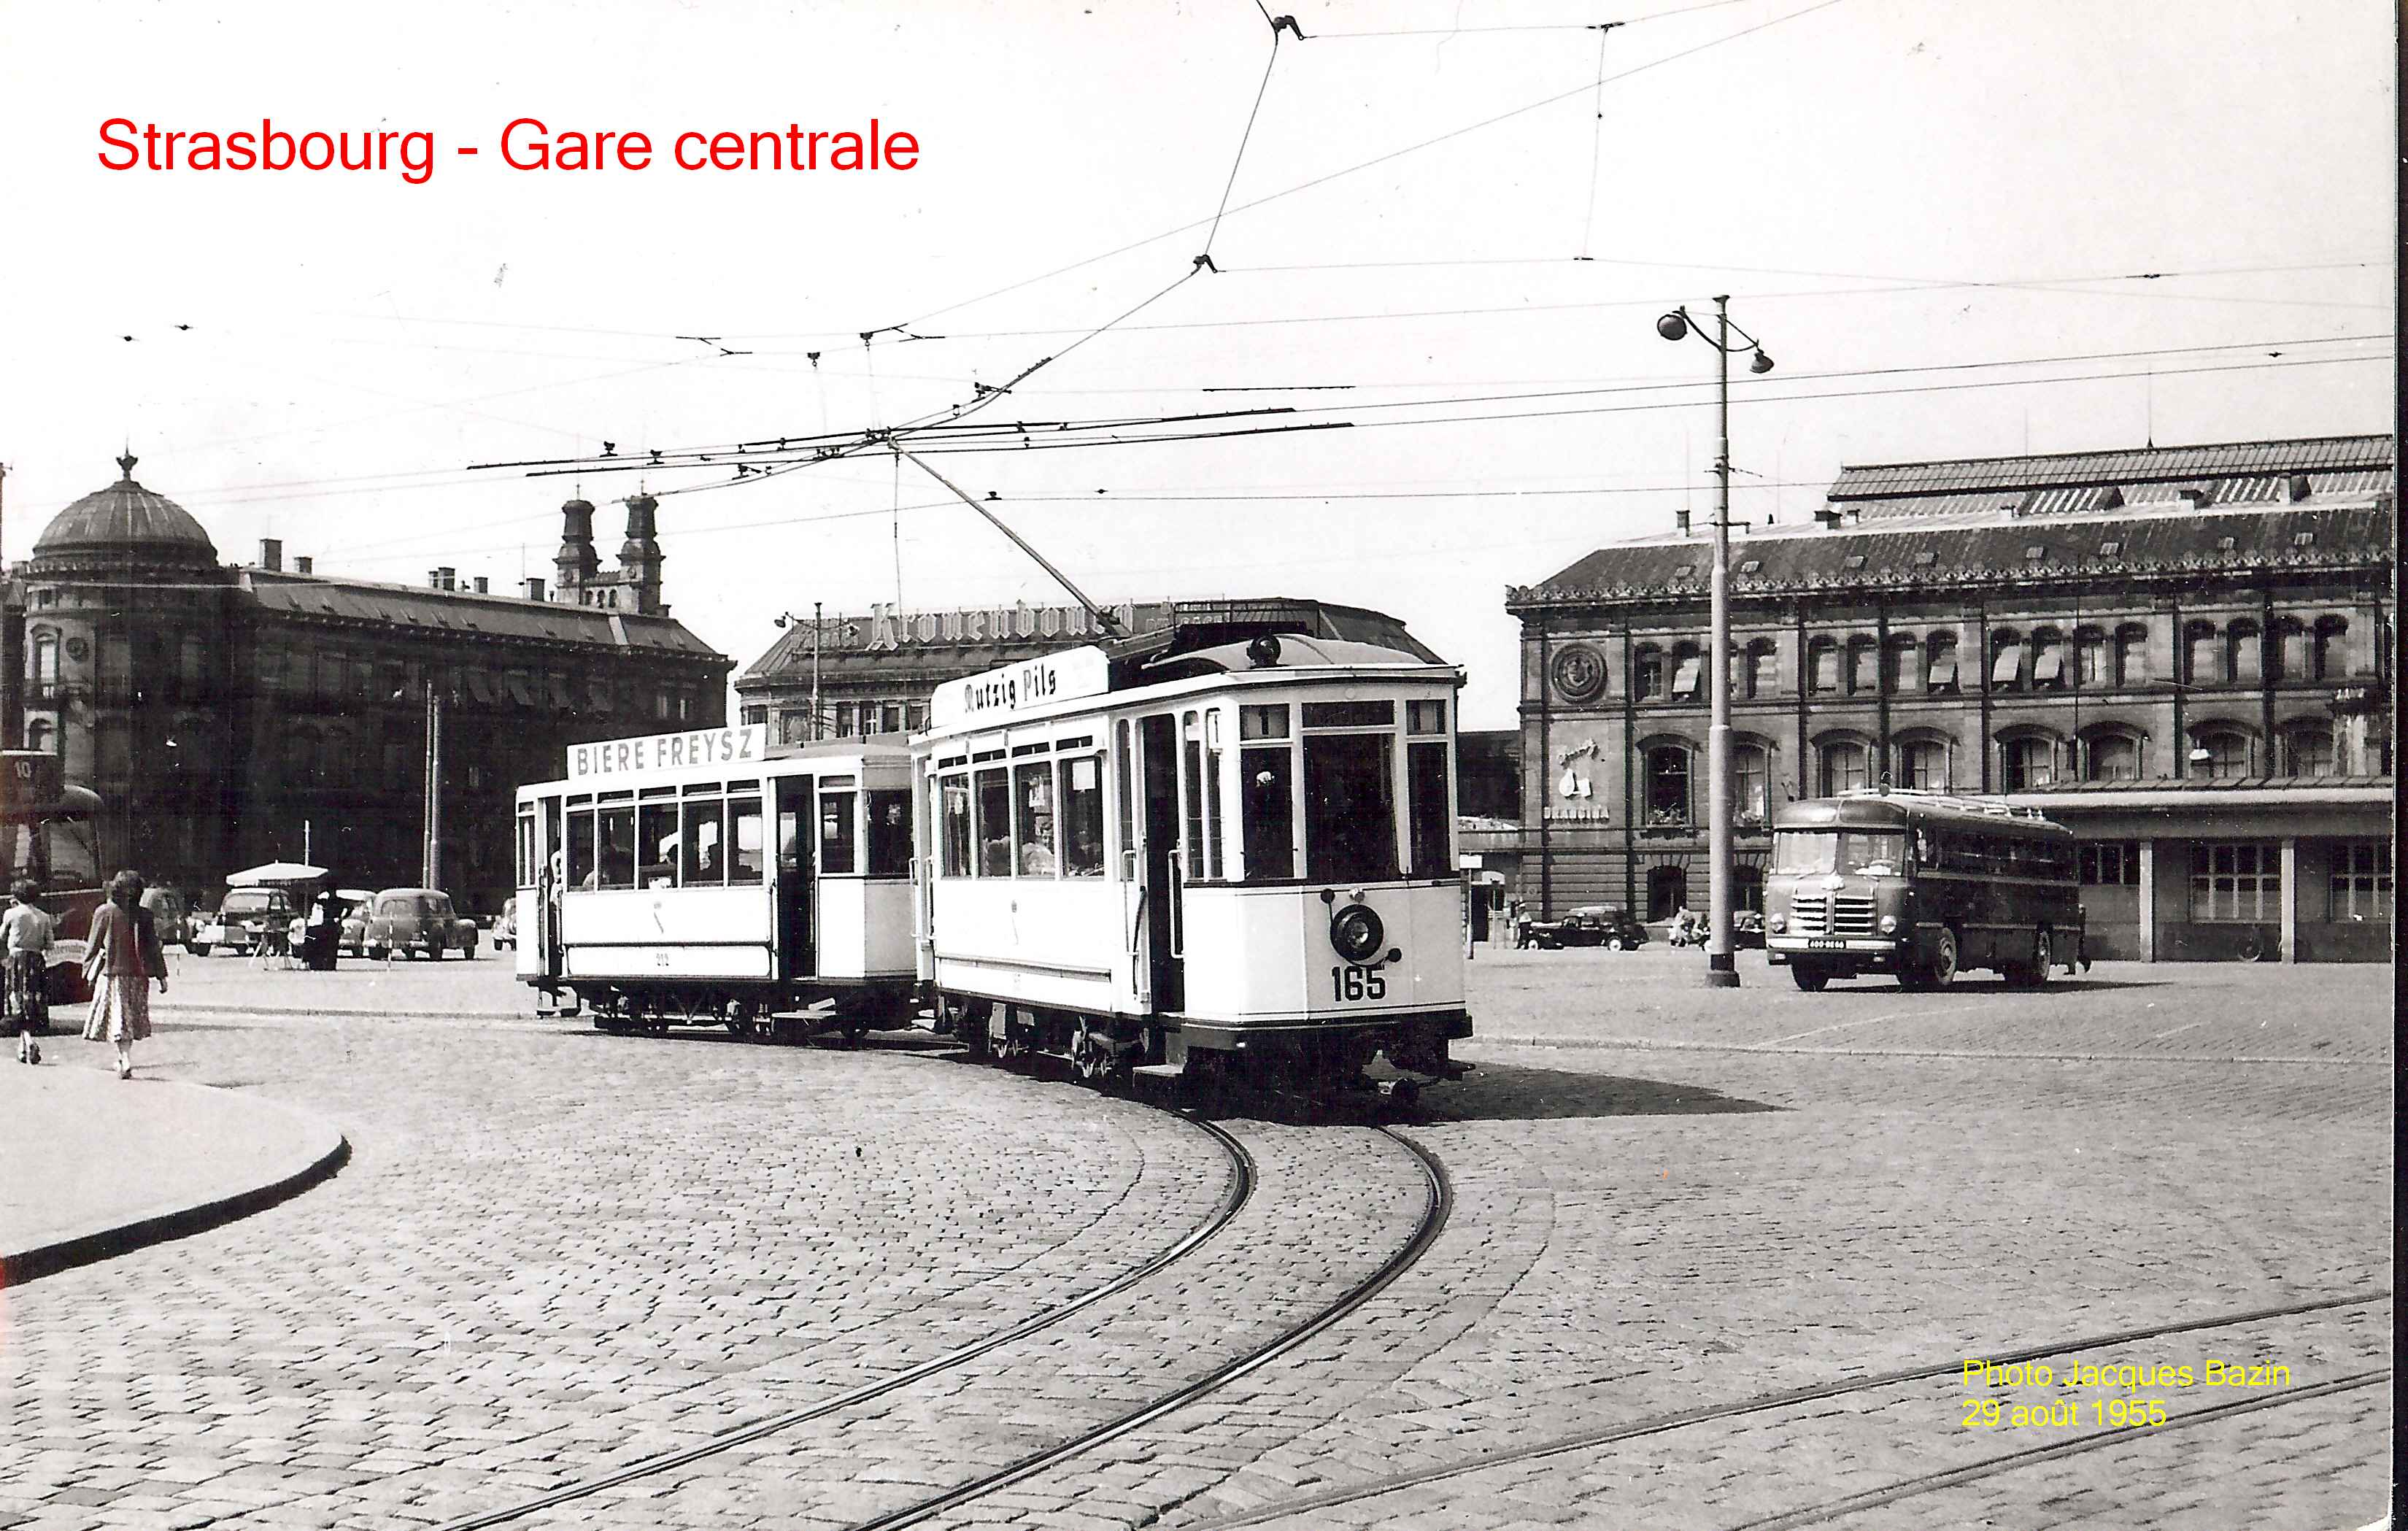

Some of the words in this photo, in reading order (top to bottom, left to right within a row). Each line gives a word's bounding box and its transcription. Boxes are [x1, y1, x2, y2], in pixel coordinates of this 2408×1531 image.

[1023, 663, 1056, 701] Pils
[15, 761, 31, 778] 10
[577, 741, 644, 776] BIERE
[657, 729, 752, 767] FREYSZ
[1331, 965, 1386, 1002] 165
